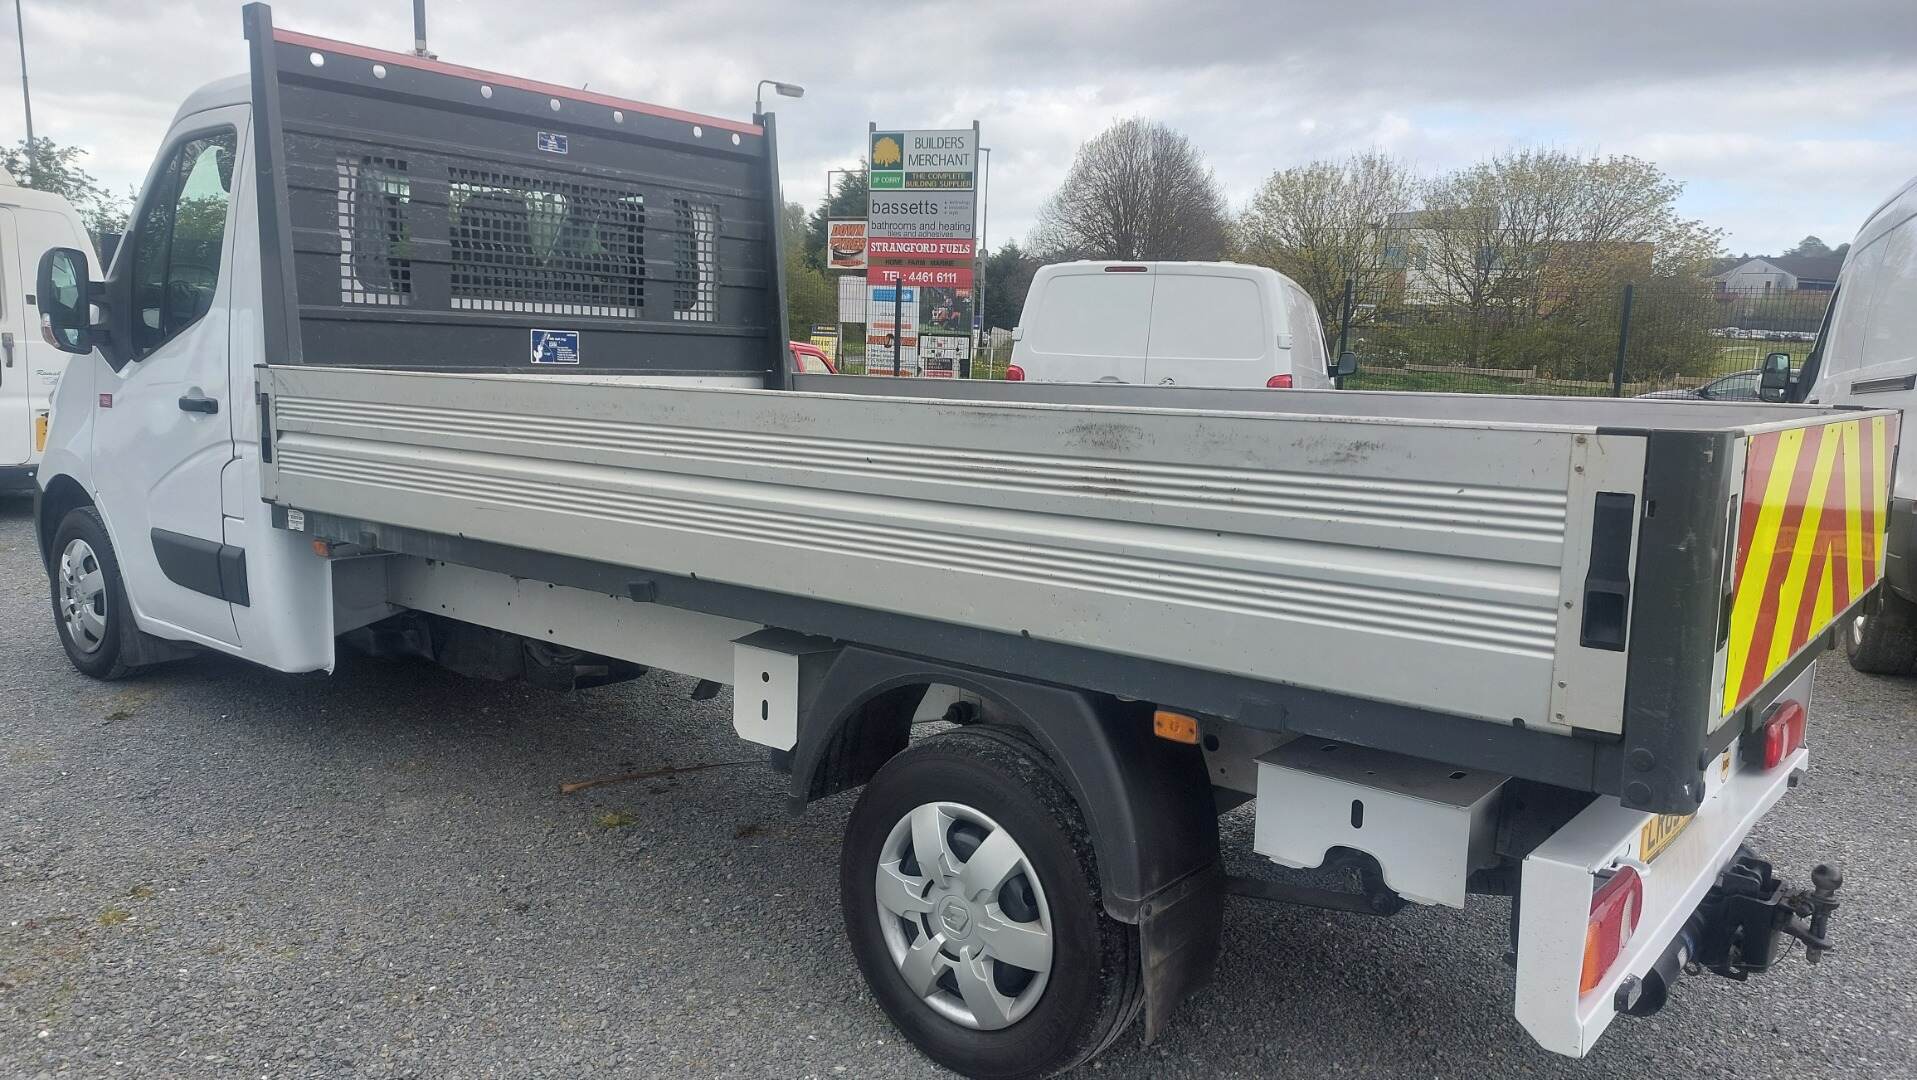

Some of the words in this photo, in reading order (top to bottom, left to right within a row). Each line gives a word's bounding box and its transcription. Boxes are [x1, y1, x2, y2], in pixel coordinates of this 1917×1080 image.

[914, 136, 964, 149] BUILDERS
[908, 154, 970, 166] MERCHANT
[872, 200, 938, 214] bassetts
[830, 224, 866, 236] DOWN
[872, 221, 916, 230] bathrooms
[919, 221, 936, 230] and
[938, 221, 970, 232] heating
[870, 242, 938, 253] STRANGFORD
[939, 244, 970, 254] FUELS
[908, 272, 933, 282] 4461
[937, 272, 957, 283] 6111
